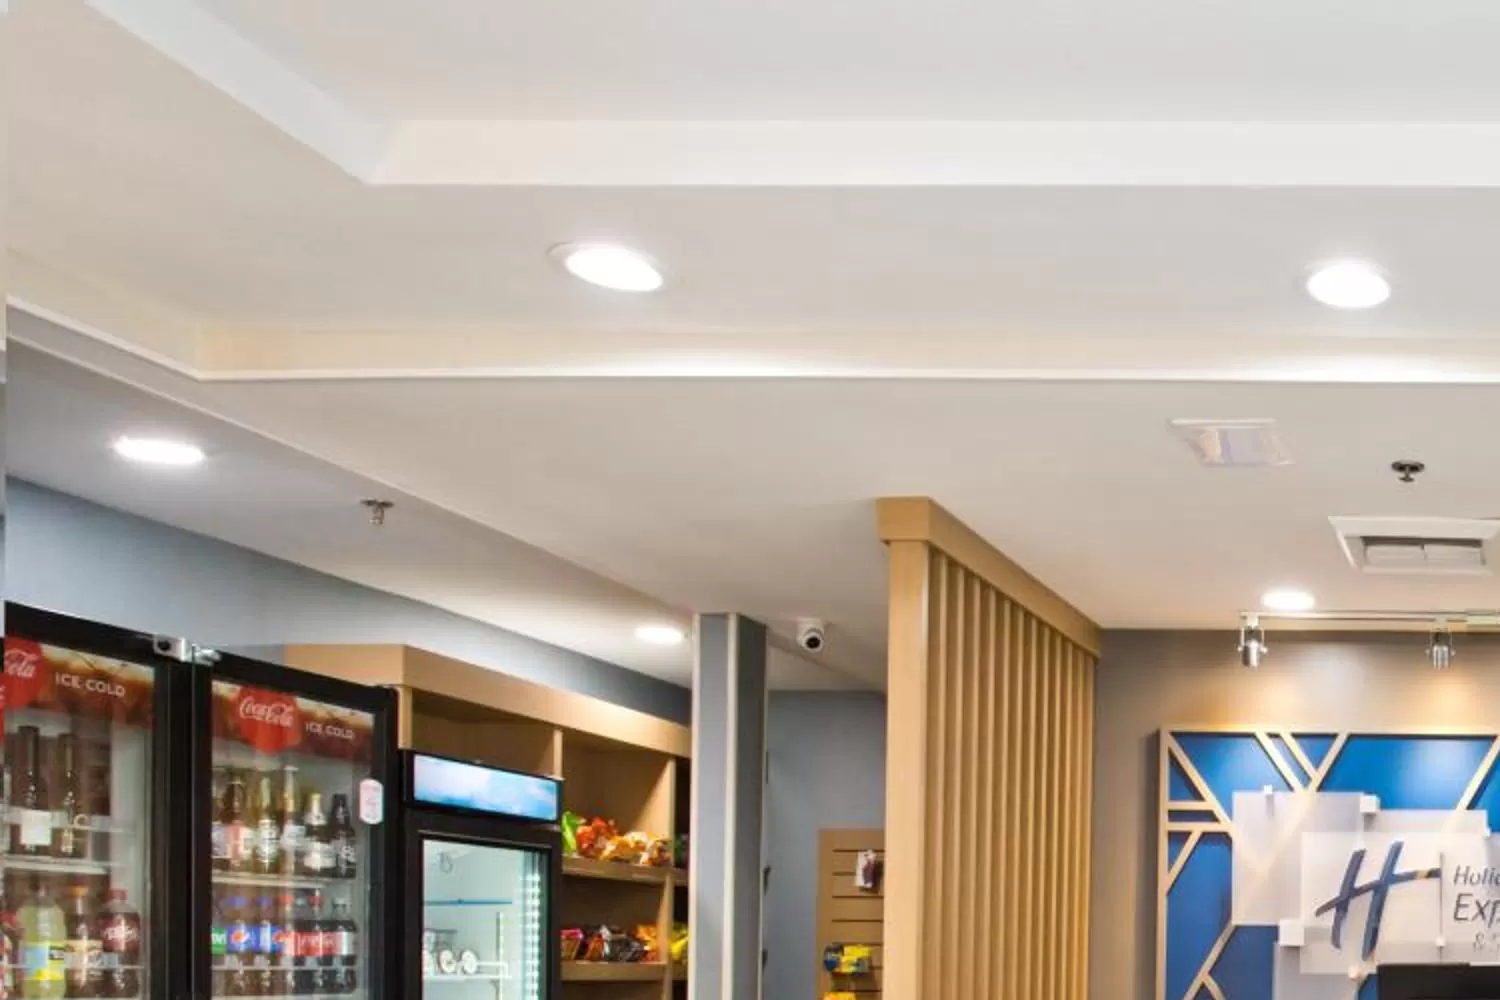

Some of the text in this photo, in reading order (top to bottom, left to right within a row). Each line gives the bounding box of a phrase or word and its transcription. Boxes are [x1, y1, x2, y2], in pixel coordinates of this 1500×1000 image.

[55, 671, 125, 697] ICE COLD
[305, 721, 356, 741] ICE COLD
